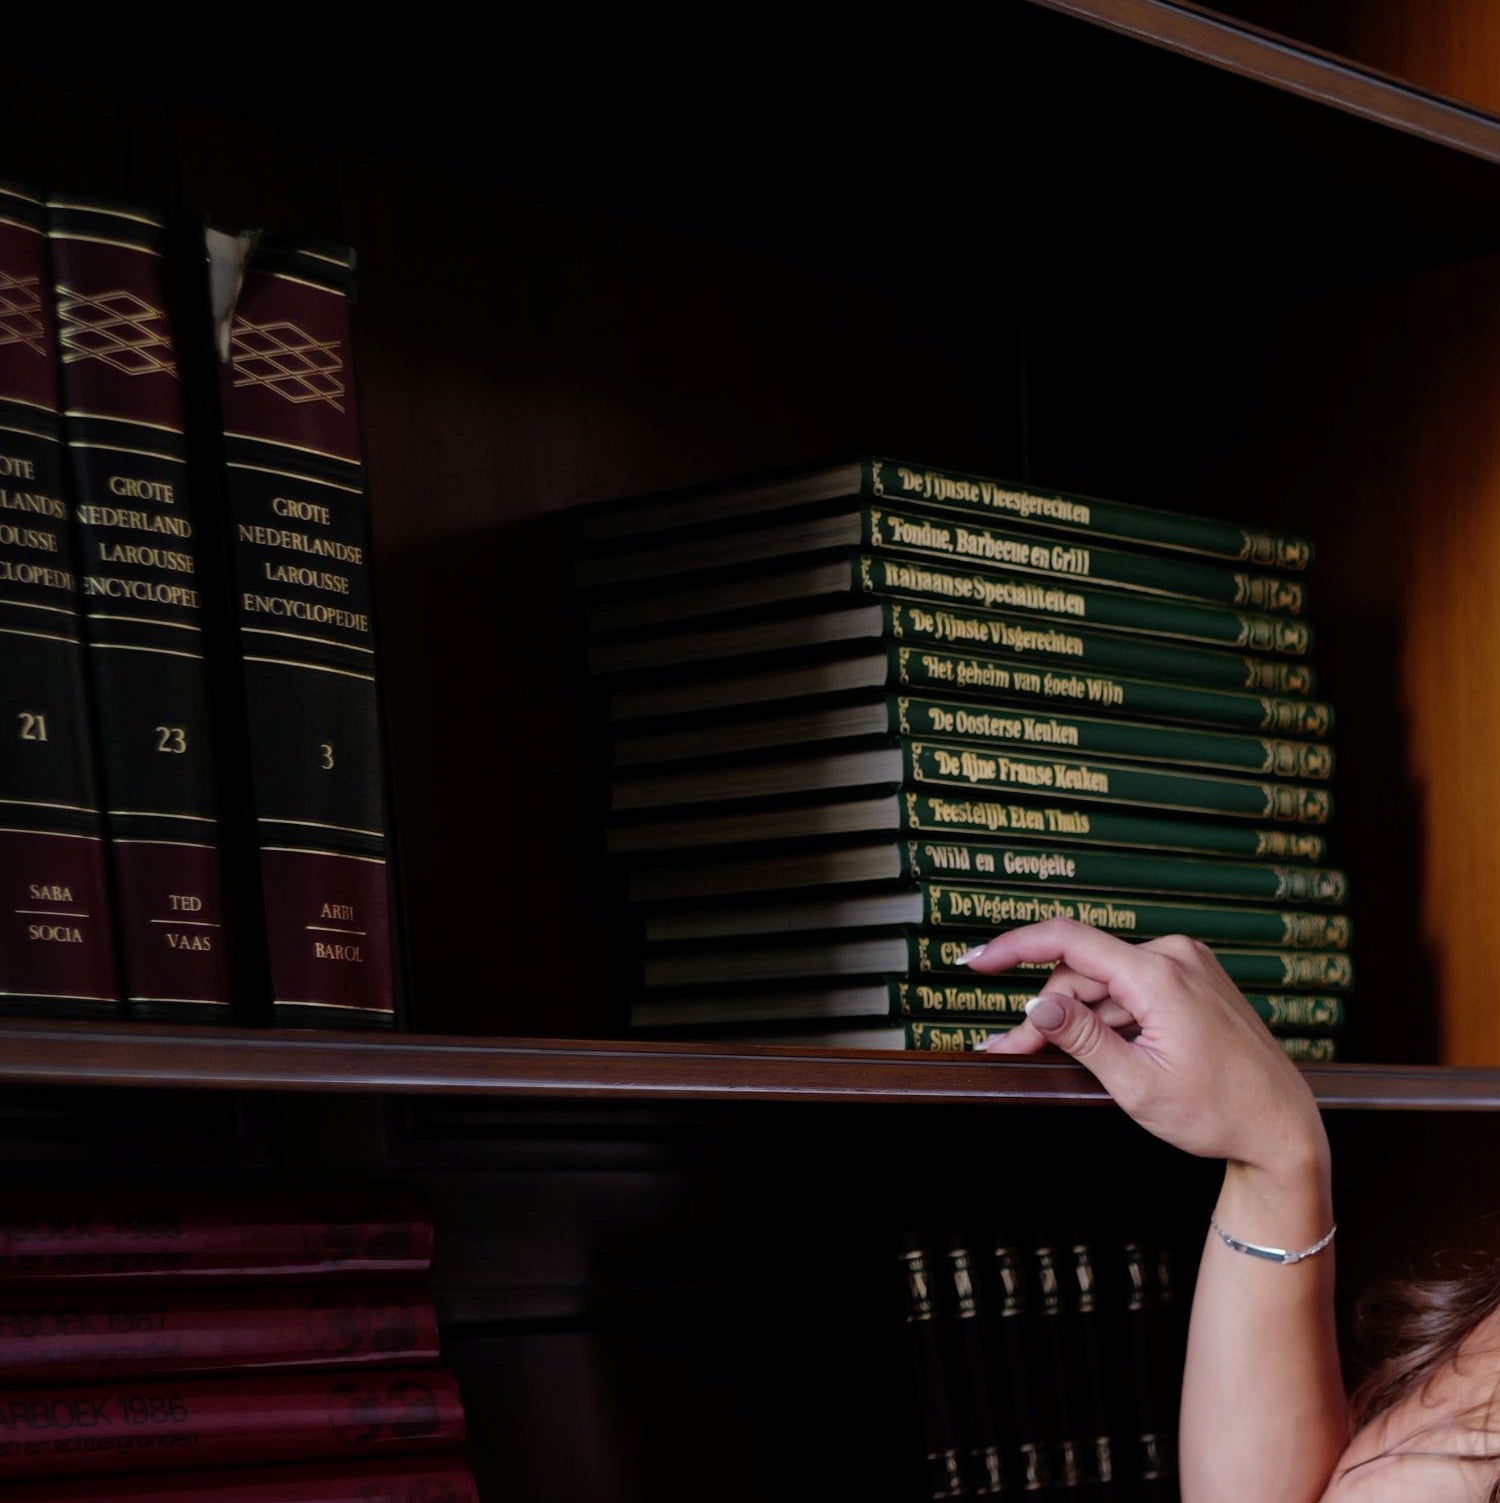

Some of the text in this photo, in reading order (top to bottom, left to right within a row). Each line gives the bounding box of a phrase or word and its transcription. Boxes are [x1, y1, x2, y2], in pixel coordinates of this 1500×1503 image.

[0, 456, 35, 480] OTE
[108, 475, 175, 504] GROTE
[897, 467, 923, 491] De
[980, 481, 1091, 525] Vleesgerechten
[76, 504, 193, 538] NEDERLAND
[272, 496, 330, 525] GROTE
[0, 524, 58, 553] OUSSE
[239, 524, 363, 565] NEDERLANDSE
[888, 515, 1091, 575] Fondue, Barbecue en Grill
[99, 542, 195, 574] LAROUSSE
[264, 562, 349, 595] LAROUSSE
[883, 560, 1086, 617] Italiaanse Specialiteiten
[242, 593, 368, 632] ENCYCLOPEDIE
[908, 608, 934, 632] De
[988, 620, 1084, 657] Visgerechten
[922, 655, 1123, 706] Het geheim van goede Wijn
[17, 711, 48, 742] 21
[153, 725, 188, 754] 23
[928, 707, 1079, 746] De Oosterse Keuken
[319, 743, 335, 770] 3
[934, 750, 1109, 793] De fijne Franse Keuken
[928, 797, 1091, 833] Feestelijk Eten Thuis
[924, 845, 1076, 881] Wild en Gevogelte
[27, 883, 73, 902] SABA
[168, 894, 202, 913] TED
[949, 892, 972, 917] De
[1076, 903, 1136, 931] Keuken
[28, 924, 83, 943] SOCIA
[165, 933, 211, 952] VAAS
[314, 942, 364, 963] BAROL
[916, 986, 1029, 1012] De Keuken va
